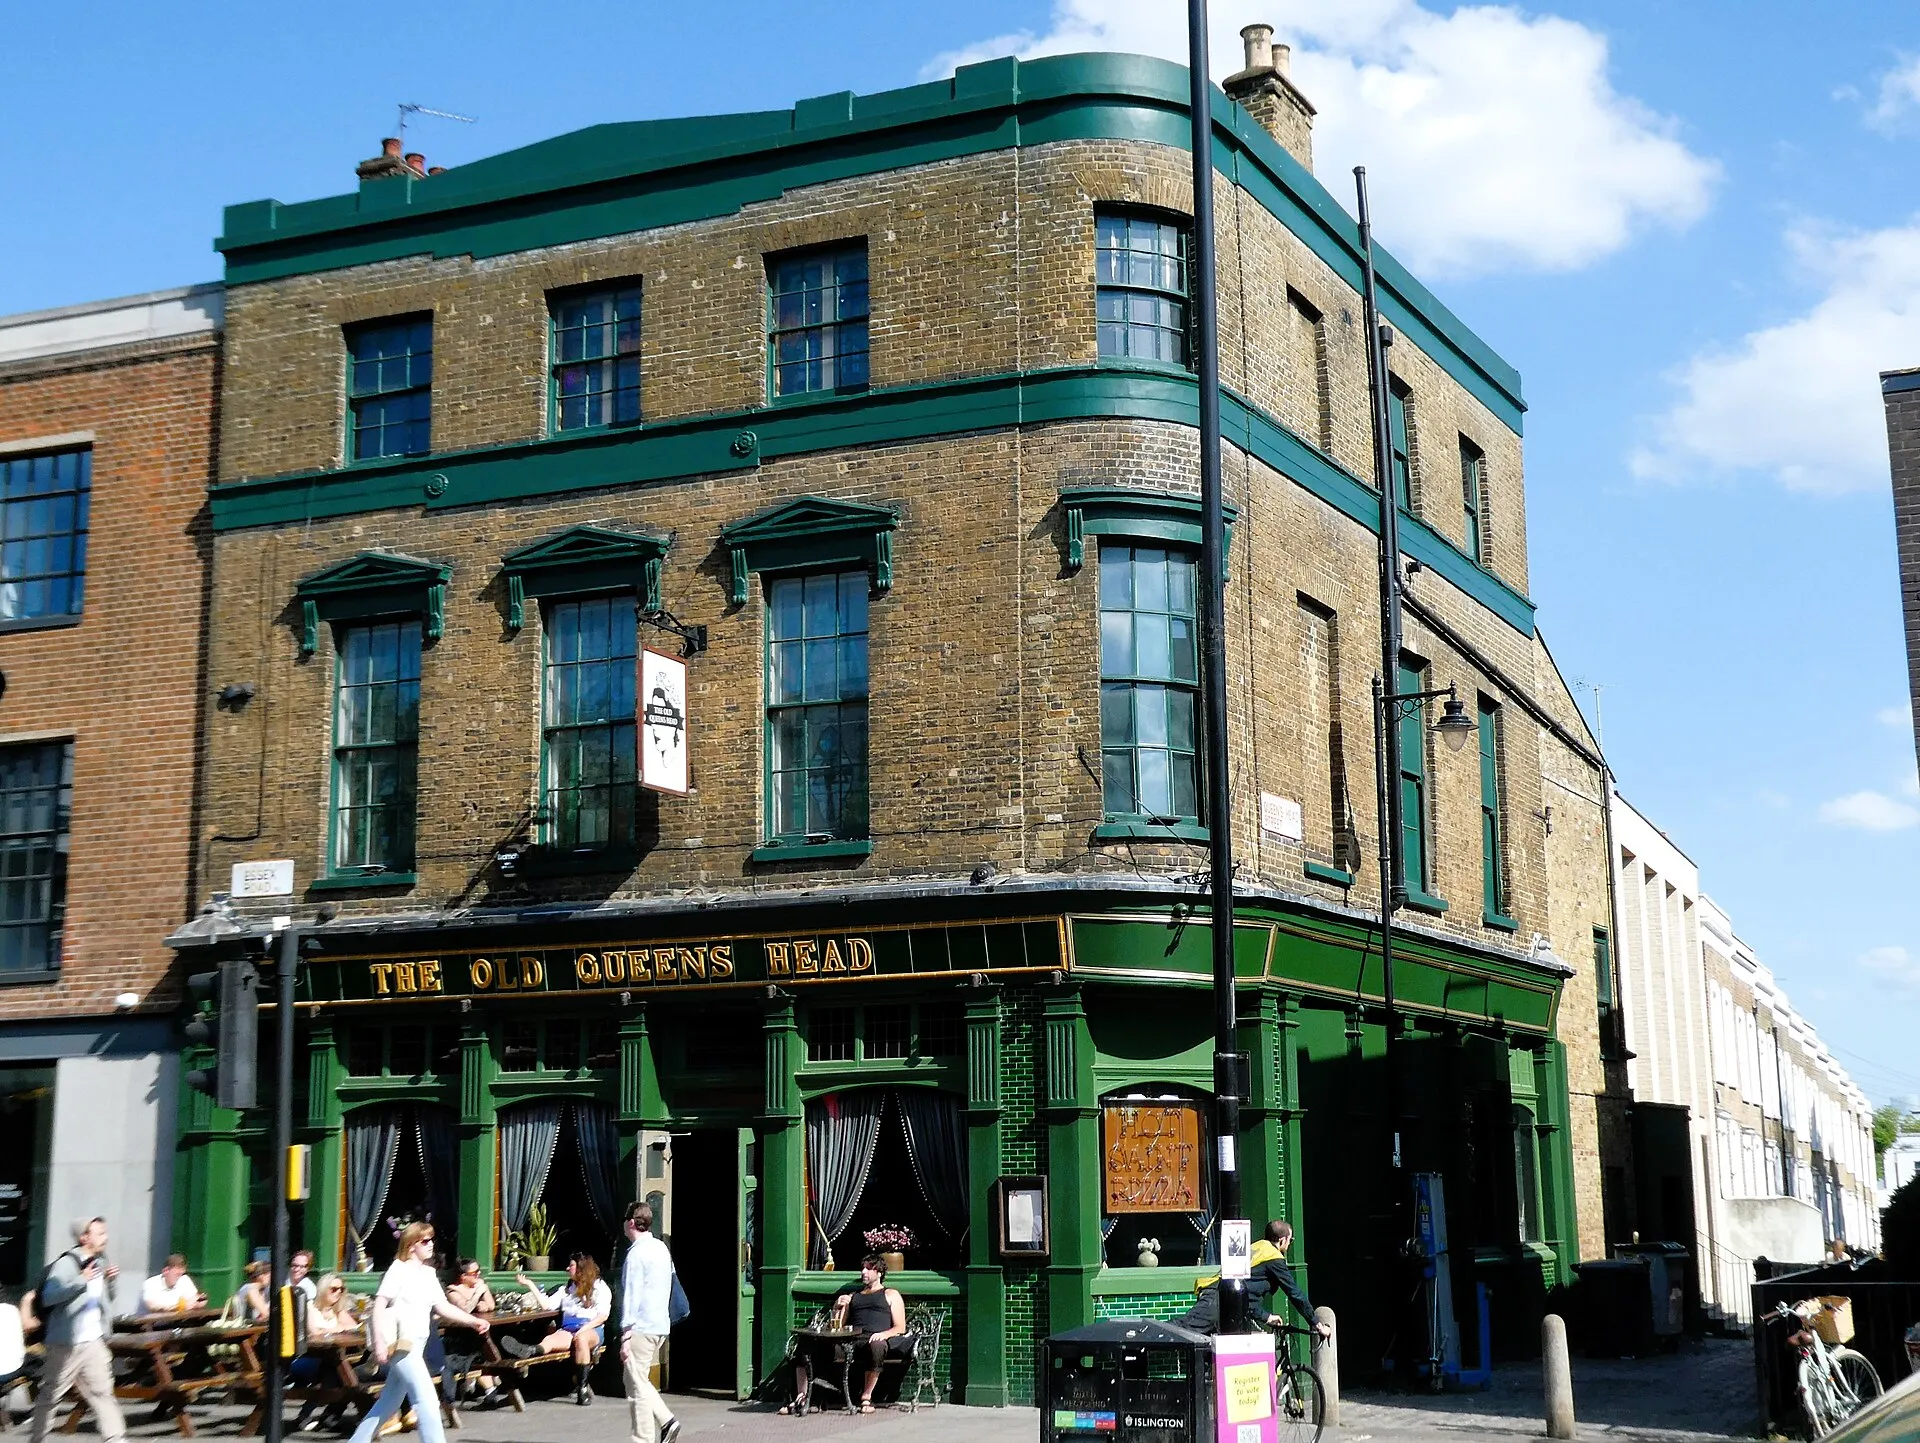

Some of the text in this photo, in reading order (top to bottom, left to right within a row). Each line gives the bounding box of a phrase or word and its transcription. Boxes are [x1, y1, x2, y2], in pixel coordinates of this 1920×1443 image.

[1264, 814, 1283, 830] STREET
[244, 869, 276, 882] ESSEX
[244, 881, 271, 894] ROAD
[370, 938, 873, 994] THE OLD QUEENS HEAD
[1110, 1176, 1193, 1206] PIZZA
[1233, 1376, 1260, 1387] Register
[1236, 1386, 1260, 1396] to vote
[1134, 1417, 1184, 1428] ISLINGTON
